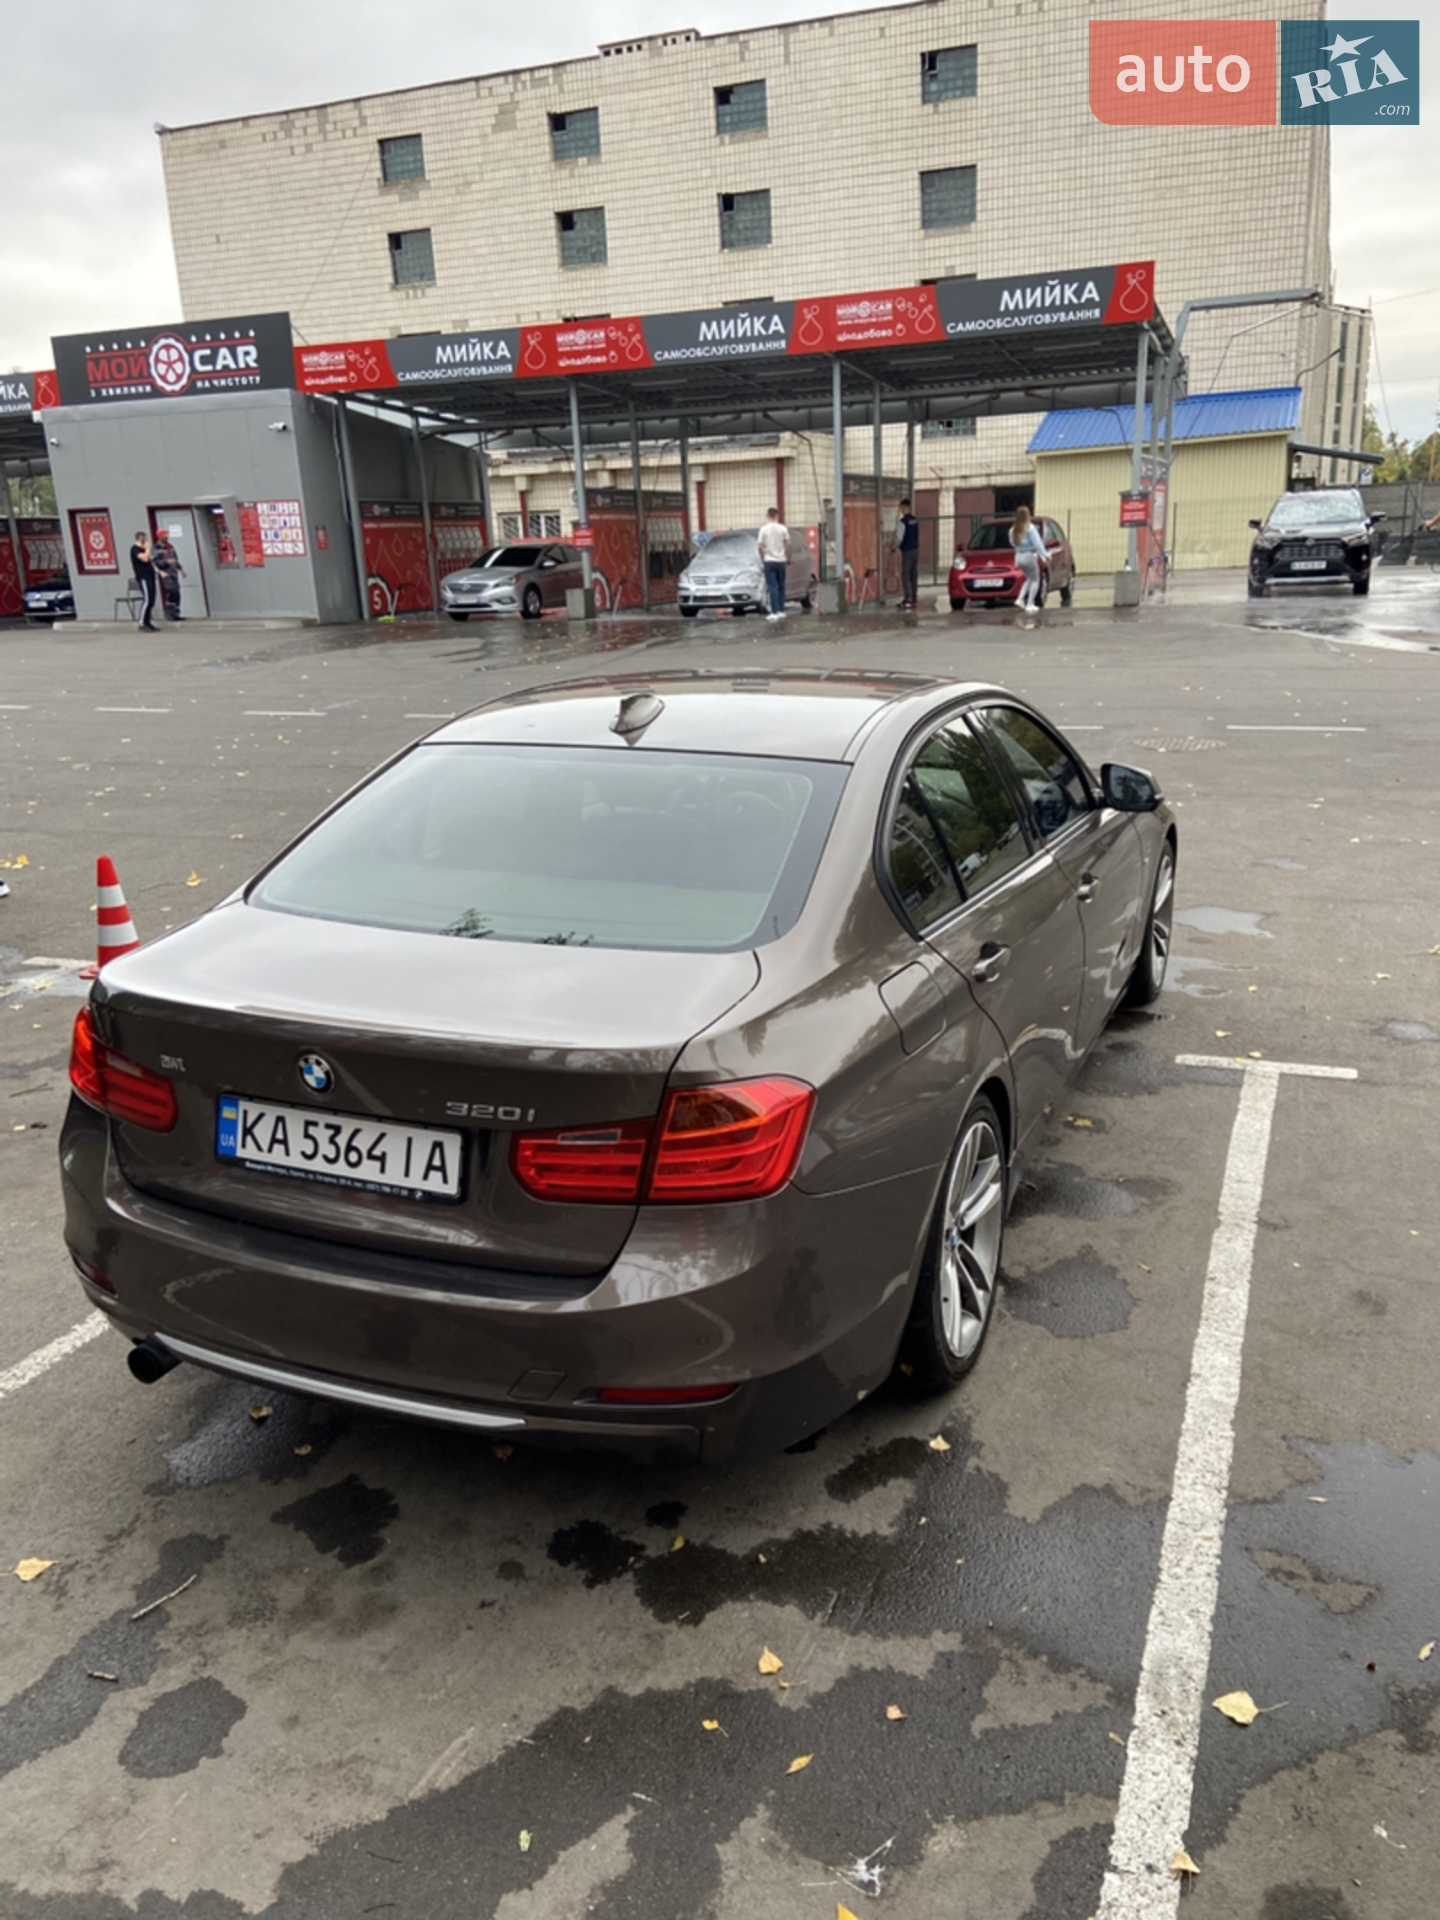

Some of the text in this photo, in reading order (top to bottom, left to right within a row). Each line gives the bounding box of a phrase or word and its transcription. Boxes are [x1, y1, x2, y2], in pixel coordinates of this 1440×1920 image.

[999, 279, 1100, 312] МИЙКА
[698, 312, 786, 342] МИЙКА
[946, 308, 1101, 333] САМООБСЛУГОВУВАННЯ
[193, 344, 259, 373] CAR
[435, 338, 512, 365] МИЙКА
[653, 339, 787, 361] САМООБСЛУГОВУВАННЯ
[397, 363, 514, 381] САМООБСЛУГОВУВАННЯ
[372, 589, 382, 610] 5
[220, 1133, 236, 1147] UA
[300, 1119, 388, 1175] 5364
